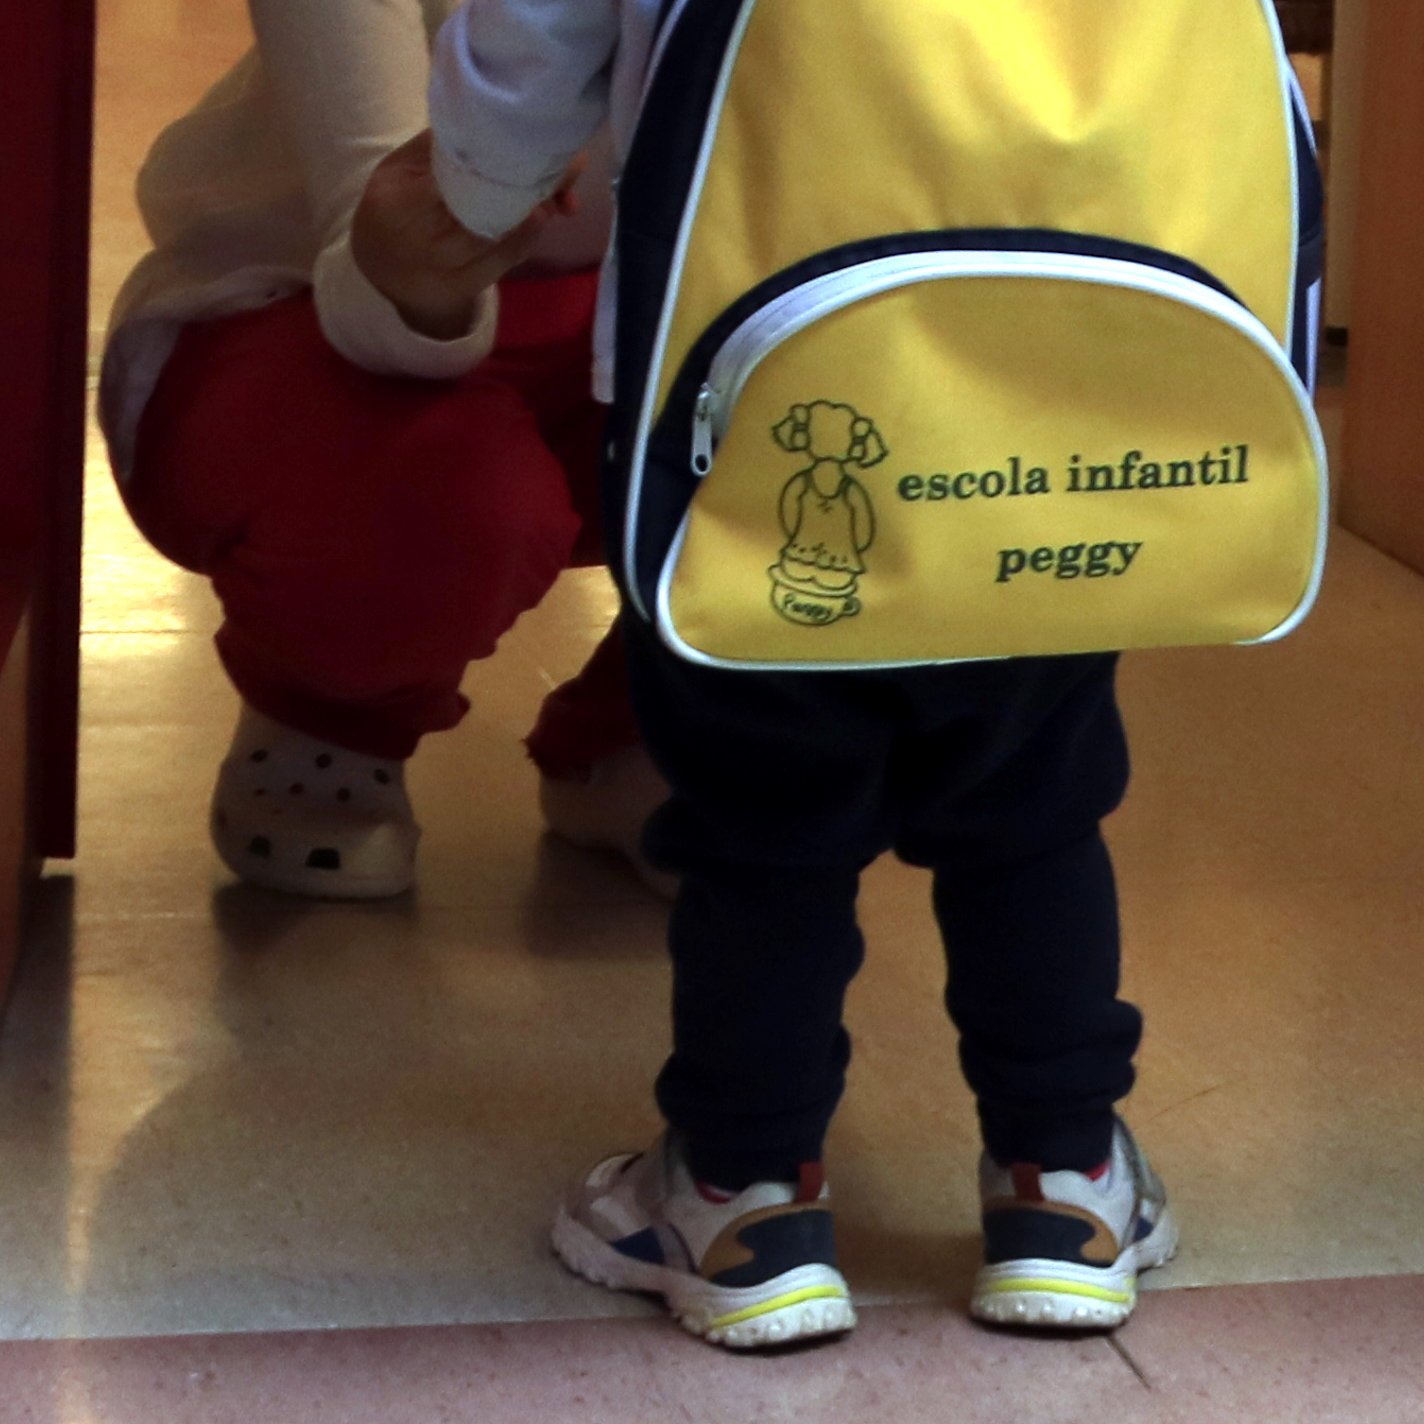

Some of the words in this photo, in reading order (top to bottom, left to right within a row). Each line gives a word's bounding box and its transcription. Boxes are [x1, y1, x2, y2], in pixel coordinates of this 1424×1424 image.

[897, 456, 1050, 502] escola
[1066, 444, 1249, 492] infantil
[995, 540, 1143, 584] peggy
